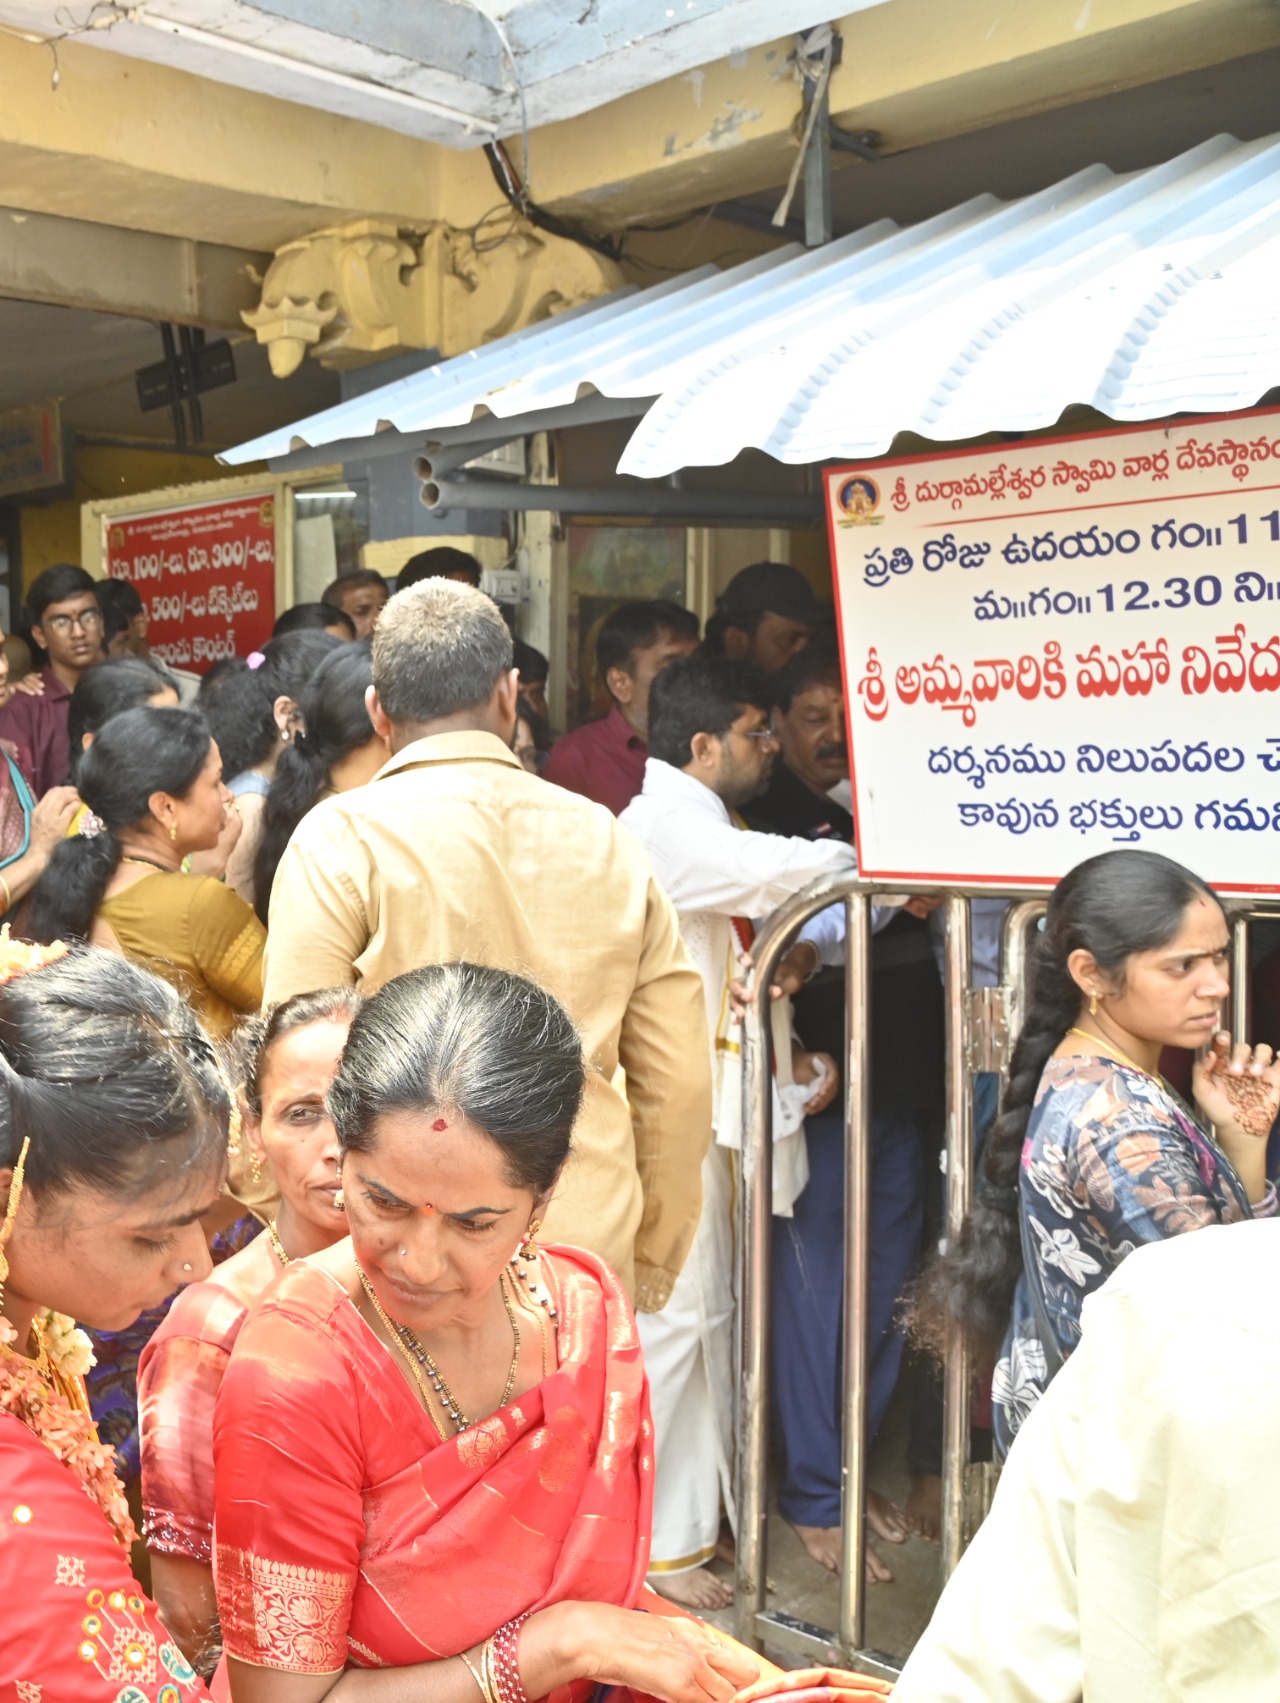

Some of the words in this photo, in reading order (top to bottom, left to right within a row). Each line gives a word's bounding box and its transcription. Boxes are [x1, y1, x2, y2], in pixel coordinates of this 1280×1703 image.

[1051, 458, 1117, 495] స్వామి
[863, 546, 915, 589] ప్రతి
[922, 532, 993, 572] రోజు
[1000, 524, 1141, 565] ఉదయం
[856, 646, 889, 722] శ్రీ
[895, 640, 1067, 728] అమ్మవారికి
[1075, 637, 1171, 698] మహా
[927, 742, 1066, 790] దర్శనము
[957, 797, 1059, 835] కావున
[1069, 798, 1183, 842] భక్తులు
